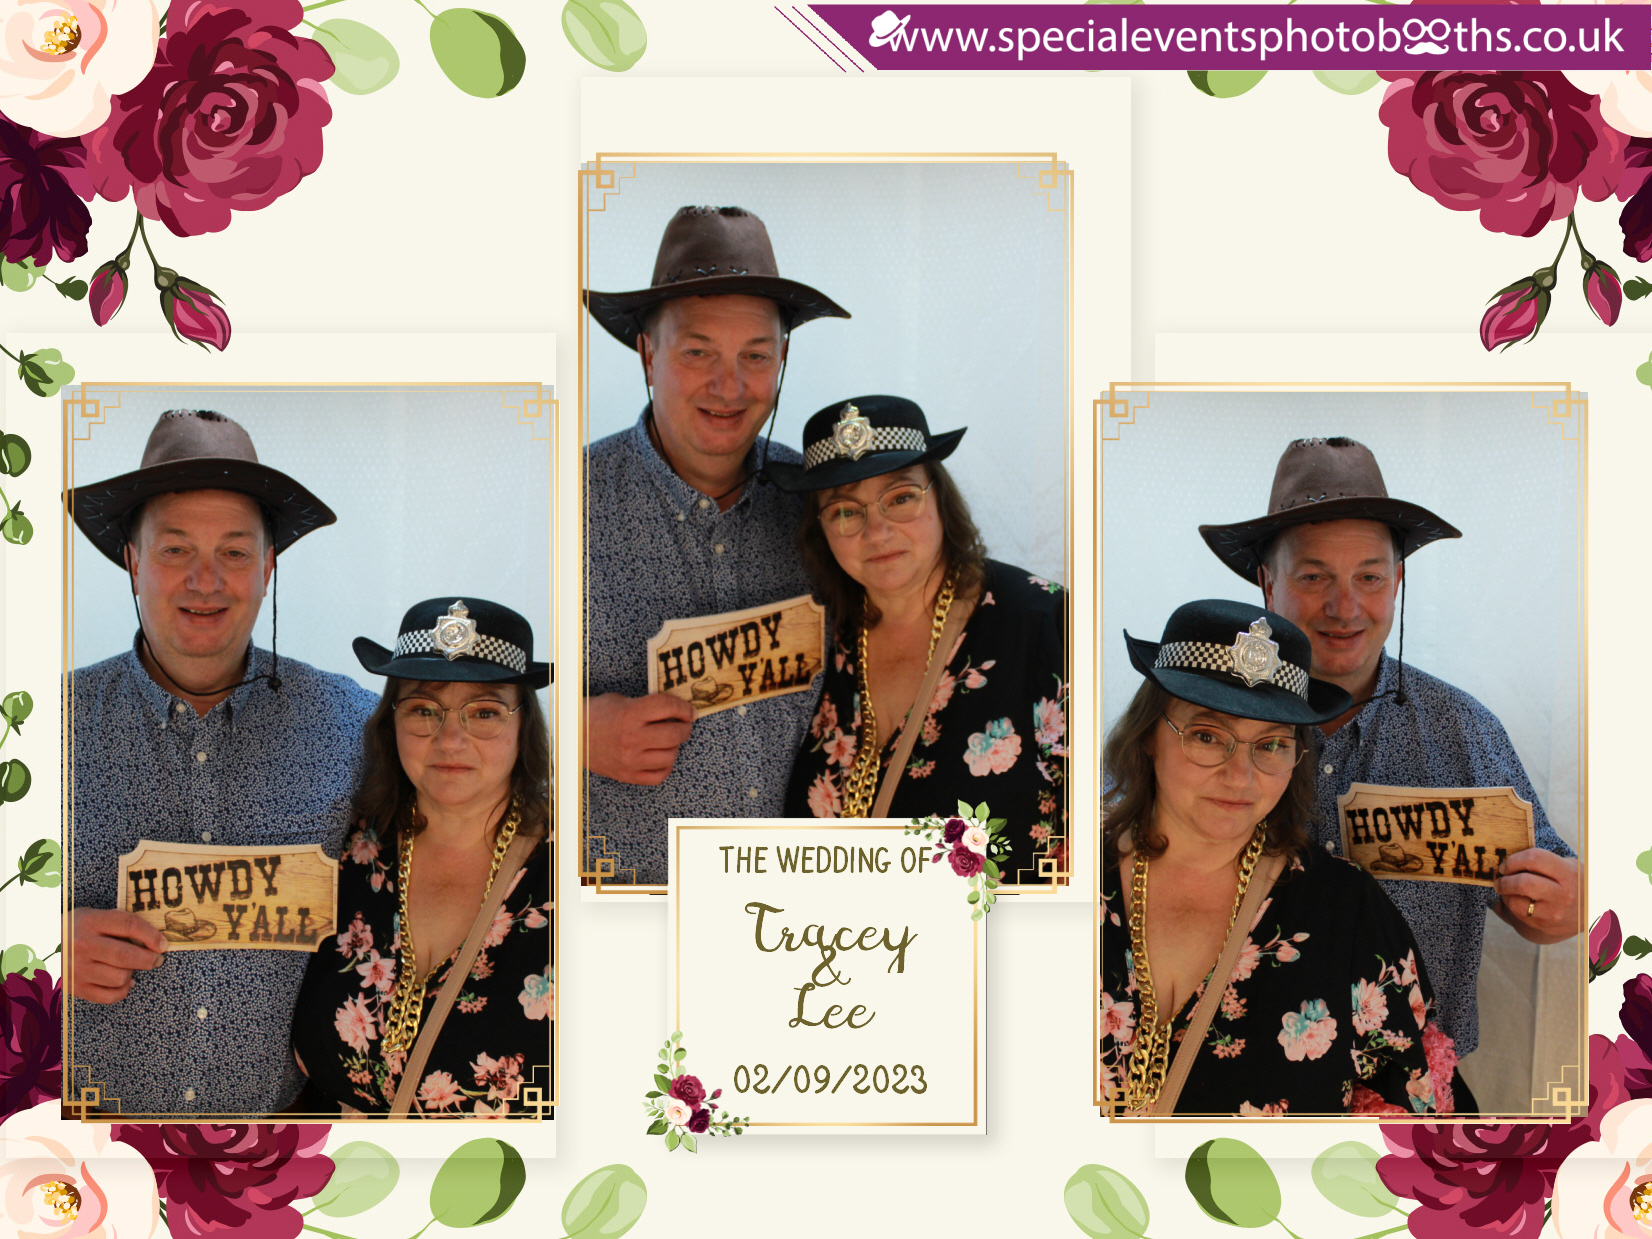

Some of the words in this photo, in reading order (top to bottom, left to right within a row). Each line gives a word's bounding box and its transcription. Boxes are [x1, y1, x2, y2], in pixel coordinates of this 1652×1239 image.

[658, 611, 782, 691] HOWDY
[738, 653, 812, 696] Y'ALL
[1346, 798, 1475, 845] HOWDY
[129, 855, 281, 913] HOWDY
[222, 901, 317, 945] Y'ALL
